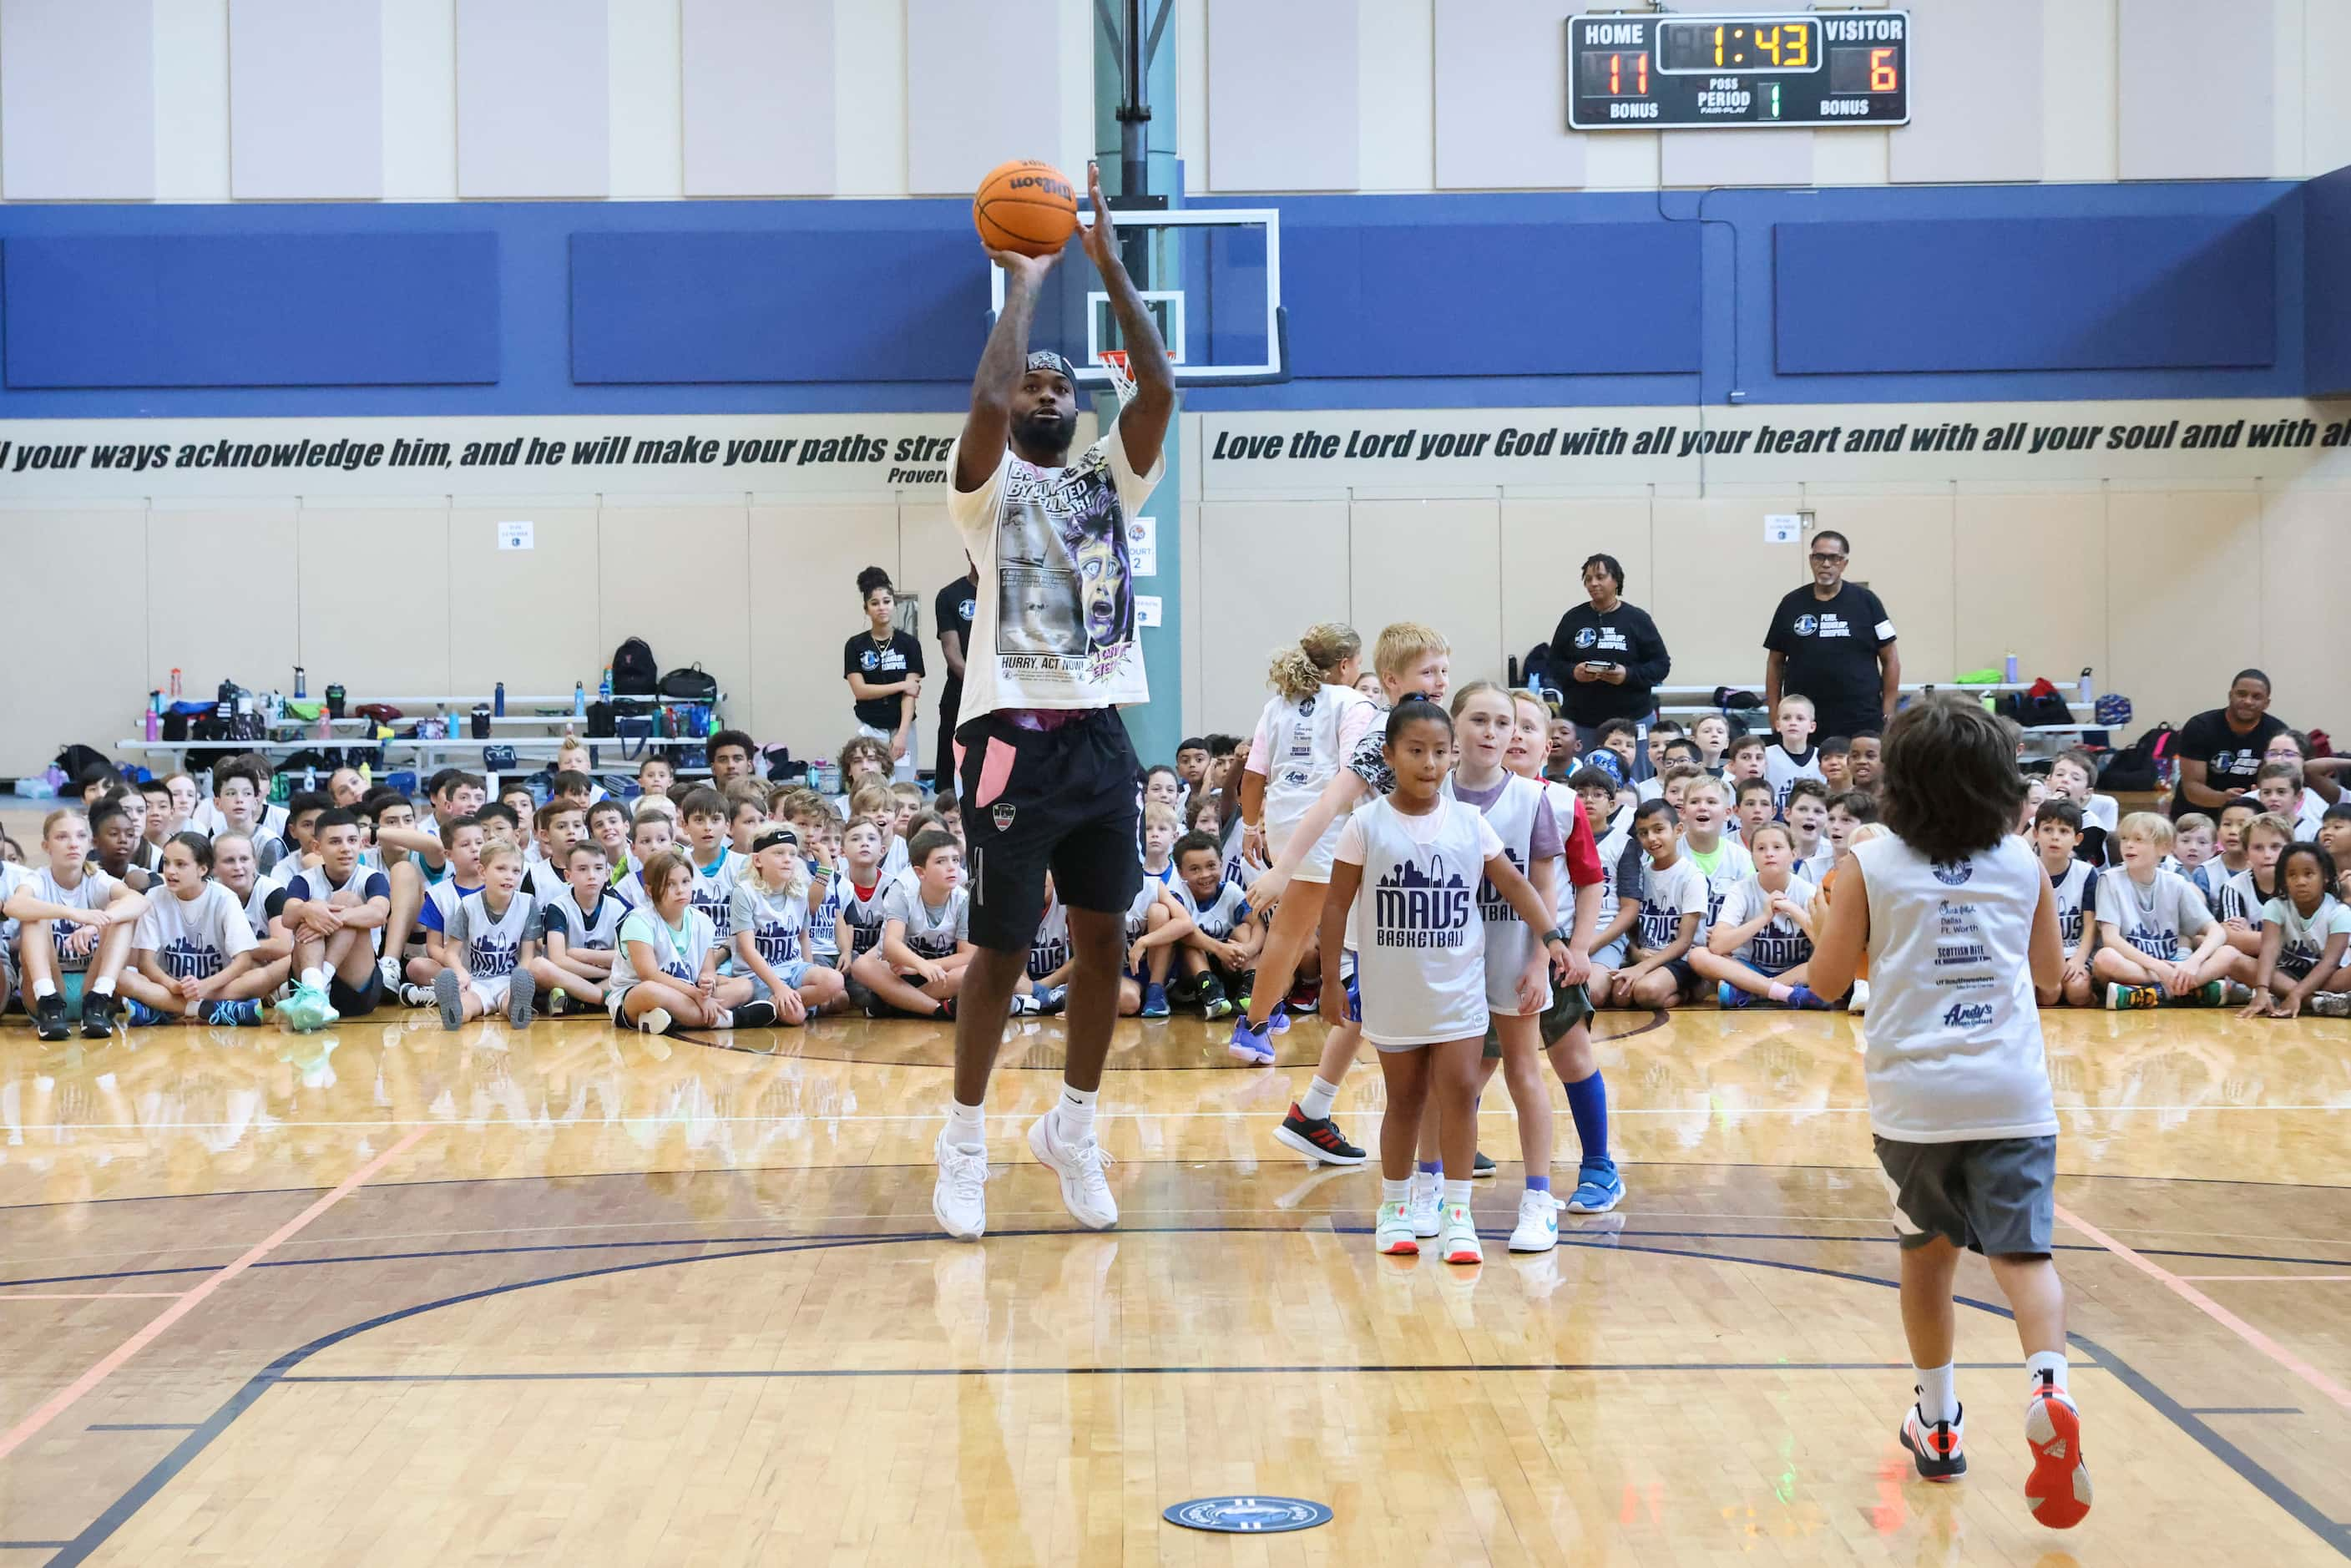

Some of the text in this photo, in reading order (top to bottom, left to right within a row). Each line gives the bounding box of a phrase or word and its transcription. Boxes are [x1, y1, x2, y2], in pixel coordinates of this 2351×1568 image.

[1585, 24, 1643, 44] HOME
[1826, 19, 1904, 41] VISITOR
[1714, 24, 1807, 68] 1:43
[1610, 53, 1648, 94] 11
[1870, 48, 1896, 91] 6
[1709, 78, 1738, 91] POSS
[1697, 91, 1751, 108] PERIOD
[1771, 83, 1781, 118] 1
[1820, 99, 1868, 115] BONUS
[1610, 103, 1658, 119] BONUS
[1009, 176, 1072, 201] Wilson
[1212, 418, 2351, 461] Love the Lord your God with all your heart and with all your soul and with al
[12, 444, 87, 472] your
[91, 443, 169, 473] ways
[174, 438, 384, 472] acknowledge
[388, 437, 453, 469] him,
[460, 436, 523, 467] and
[524, 436, 567, 466] he
[571, 436, 631, 465] will
[632, 434, 719, 465] make
[723, 438, 799, 467] your
[796, 433, 888, 466] paths
[1134, 558, 1140, 569] 2
[1002, 656, 1084, 670] HURRY, ACT NOW!
[1376, 890, 1469, 928] MAVS
[1378, 929, 1463, 948] BASKETBALL
[1944, 1004, 1992, 1024] Andy's
